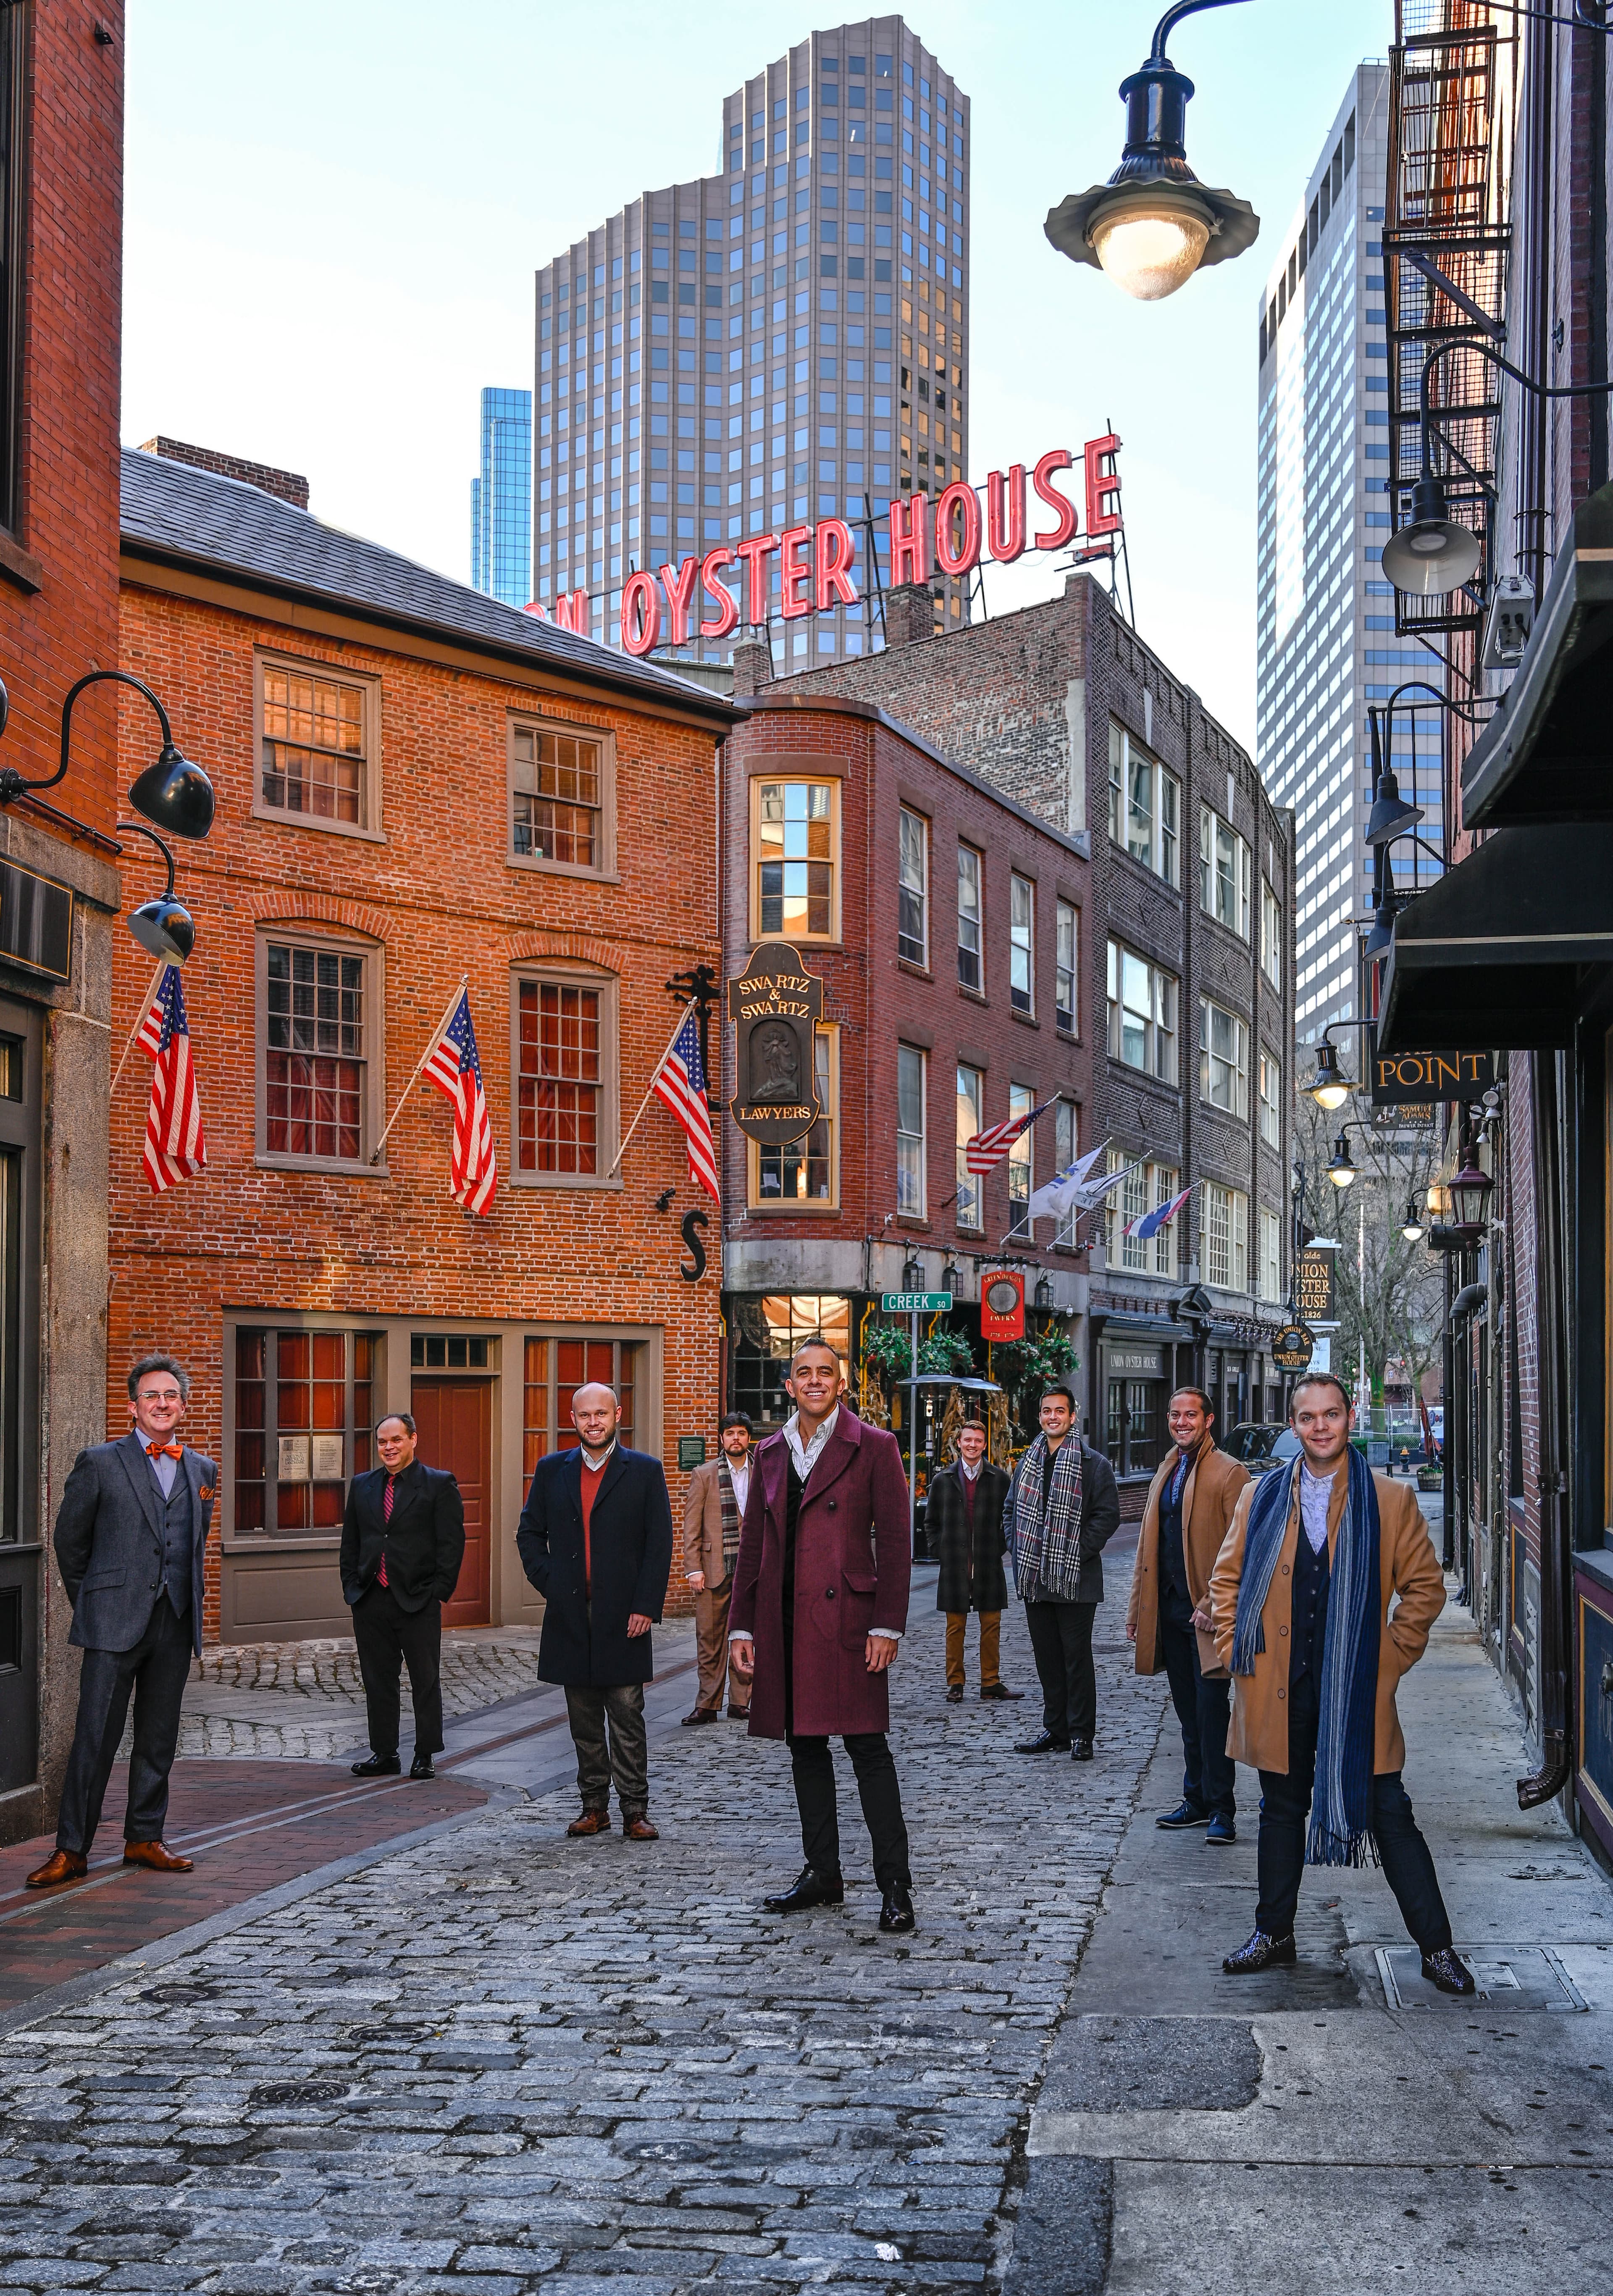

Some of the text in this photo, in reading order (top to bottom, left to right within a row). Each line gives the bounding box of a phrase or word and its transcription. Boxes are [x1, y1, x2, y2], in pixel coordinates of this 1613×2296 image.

[621, 518, 860, 656] OYSTER
[890, 434, 1124, 587] HOUSE
[738, 974, 811, 996] SWARTZ
[769, 988, 780, 1001] &
[740, 1000, 810, 1020] SWARTZ
[1377, 1051, 1486, 1090] POINT
[740, 1106, 811, 1120] LAWYERS
[1398, 1104, 1432, 1114] SAMUEL
[1401, 1112, 1430, 1122] ADAMS
[984, 1273, 1022, 1283] GREEN DRAGON
[888, 1295, 929, 1309] CREEK
[1275, 1332, 1284, 1344] THE
[1300, 1333, 1310, 1346] BAR
[1111, 1354, 1156, 1368] UNION OYSTER HOUSE
